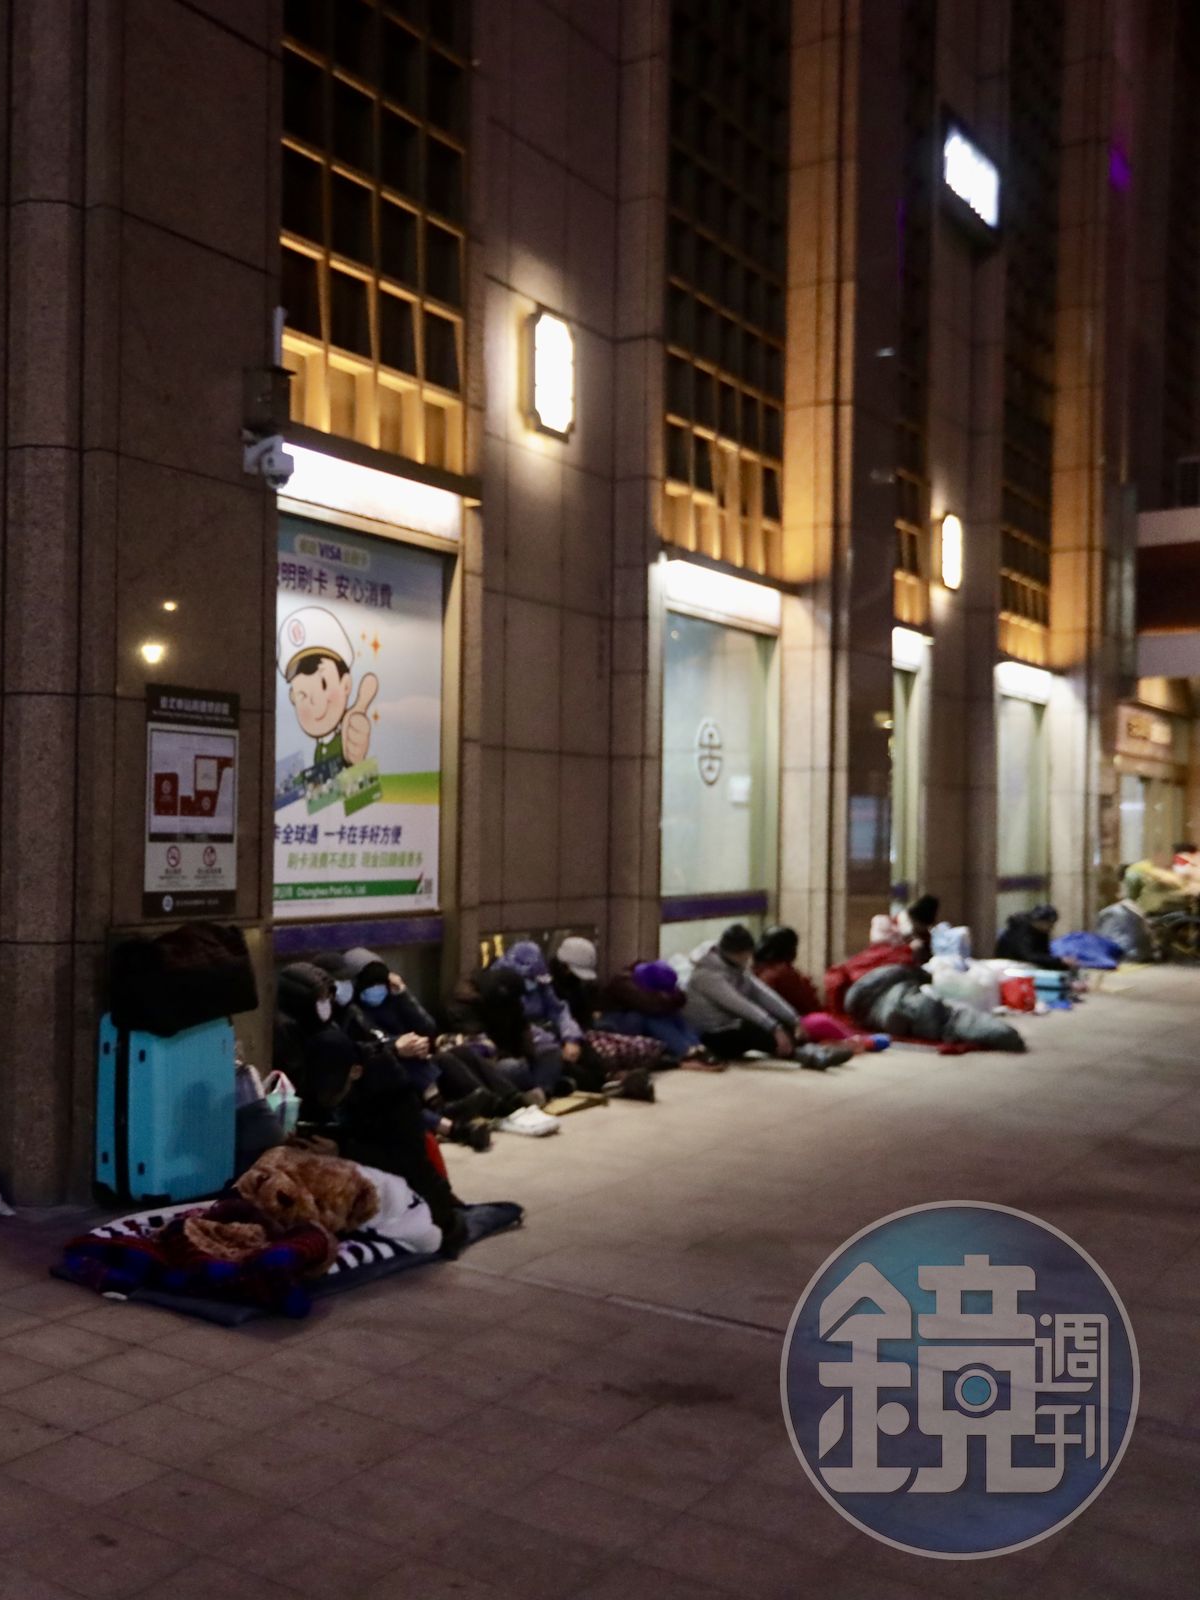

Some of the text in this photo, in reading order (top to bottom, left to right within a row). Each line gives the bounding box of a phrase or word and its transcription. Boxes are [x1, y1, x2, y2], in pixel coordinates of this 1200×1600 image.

[319, 542, 342, 561] VISA
[335, 572, 393, 609] 安心消費
[324, 825, 402, 845] 一卡在手好方便
